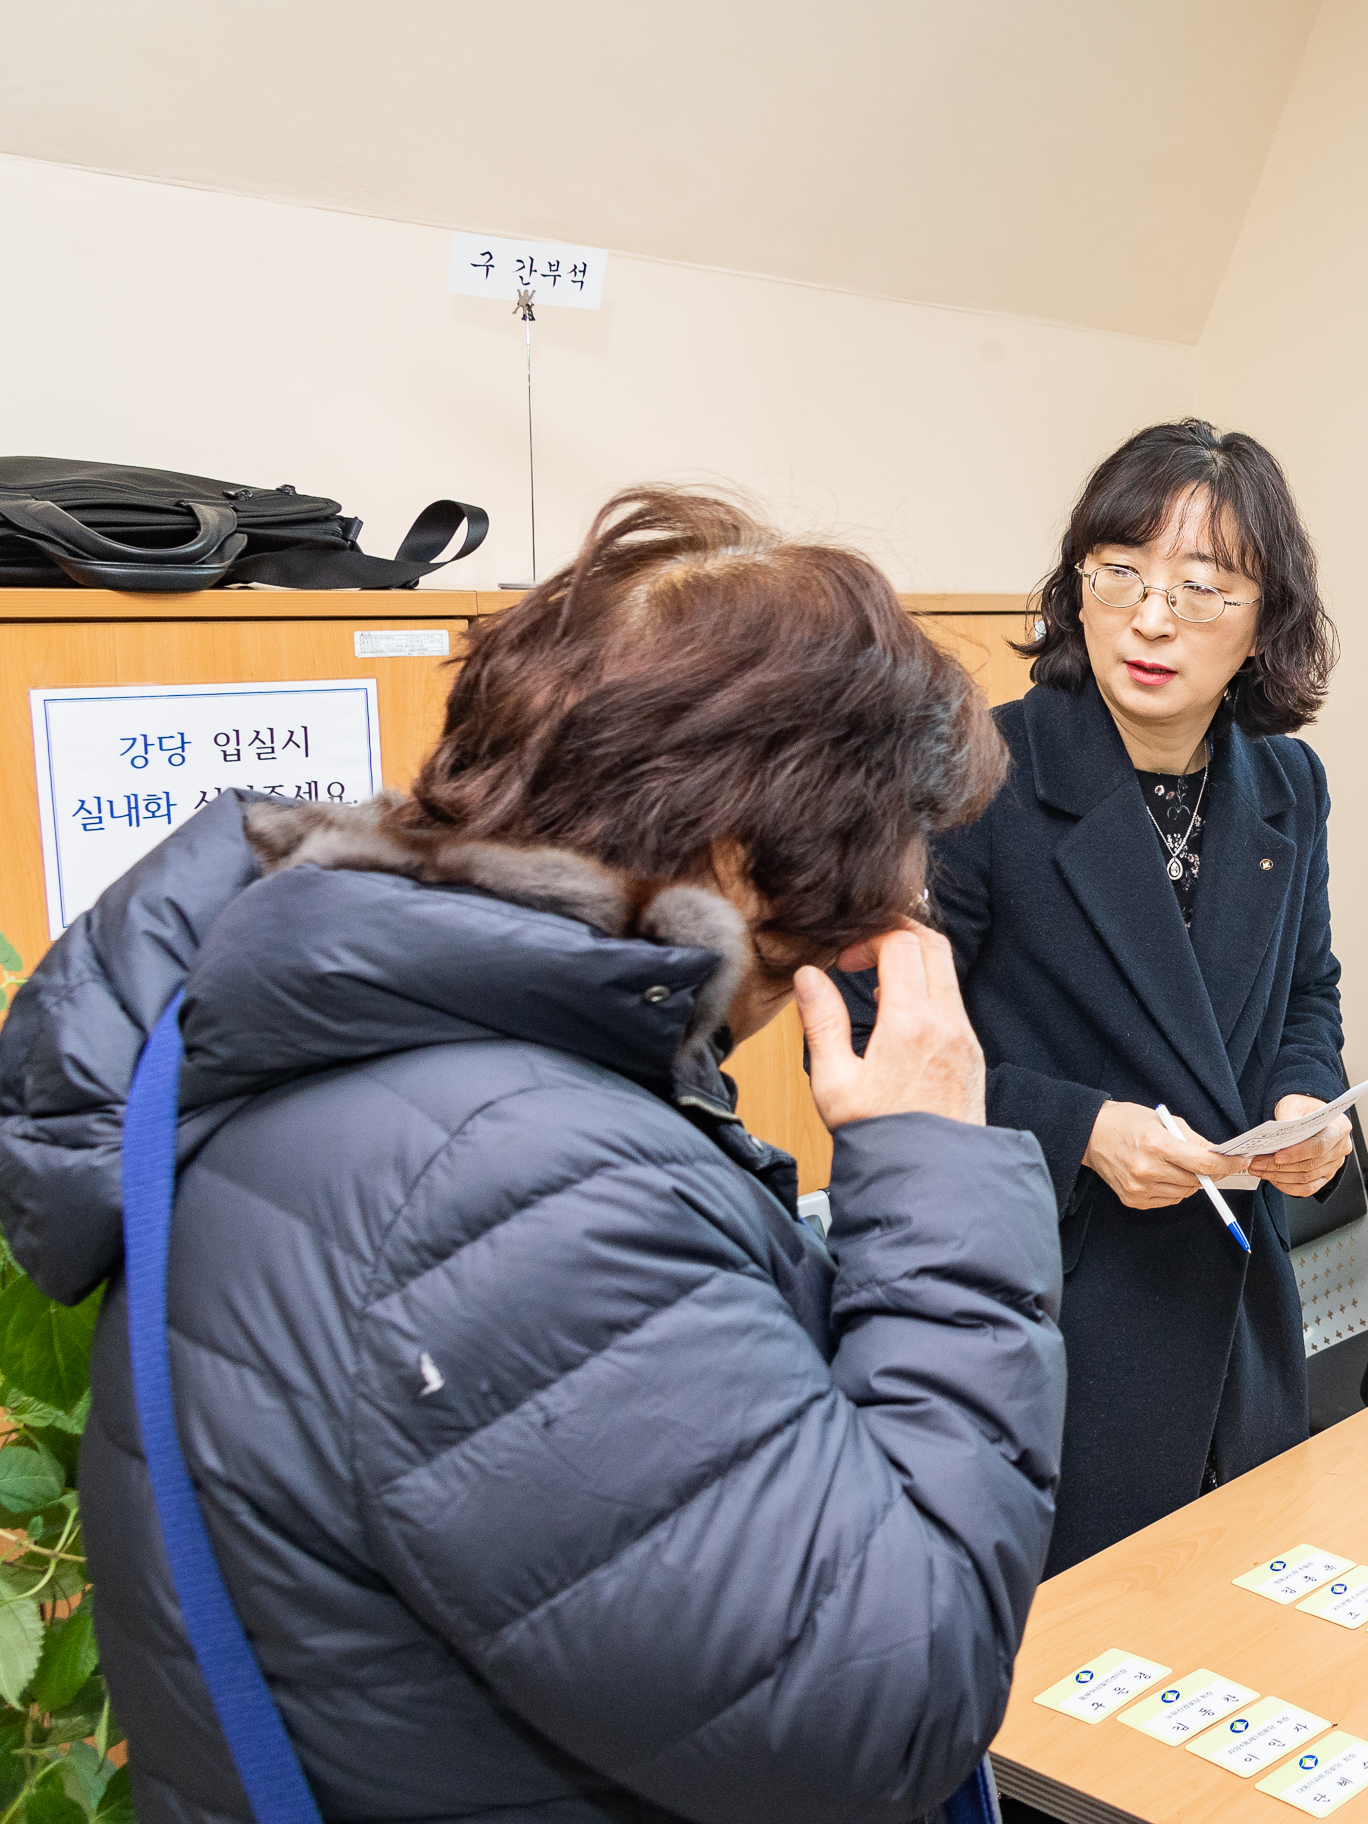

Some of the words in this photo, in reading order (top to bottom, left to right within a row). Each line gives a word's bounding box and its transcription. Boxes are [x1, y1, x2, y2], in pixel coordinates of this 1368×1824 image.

[470, 250, 495, 280] 구
[512, 256, 588, 291] 간부석
[119, 733, 192, 769] 강당
[213, 725, 311, 763] 입실시
[72, 791, 177, 832] 실내화
